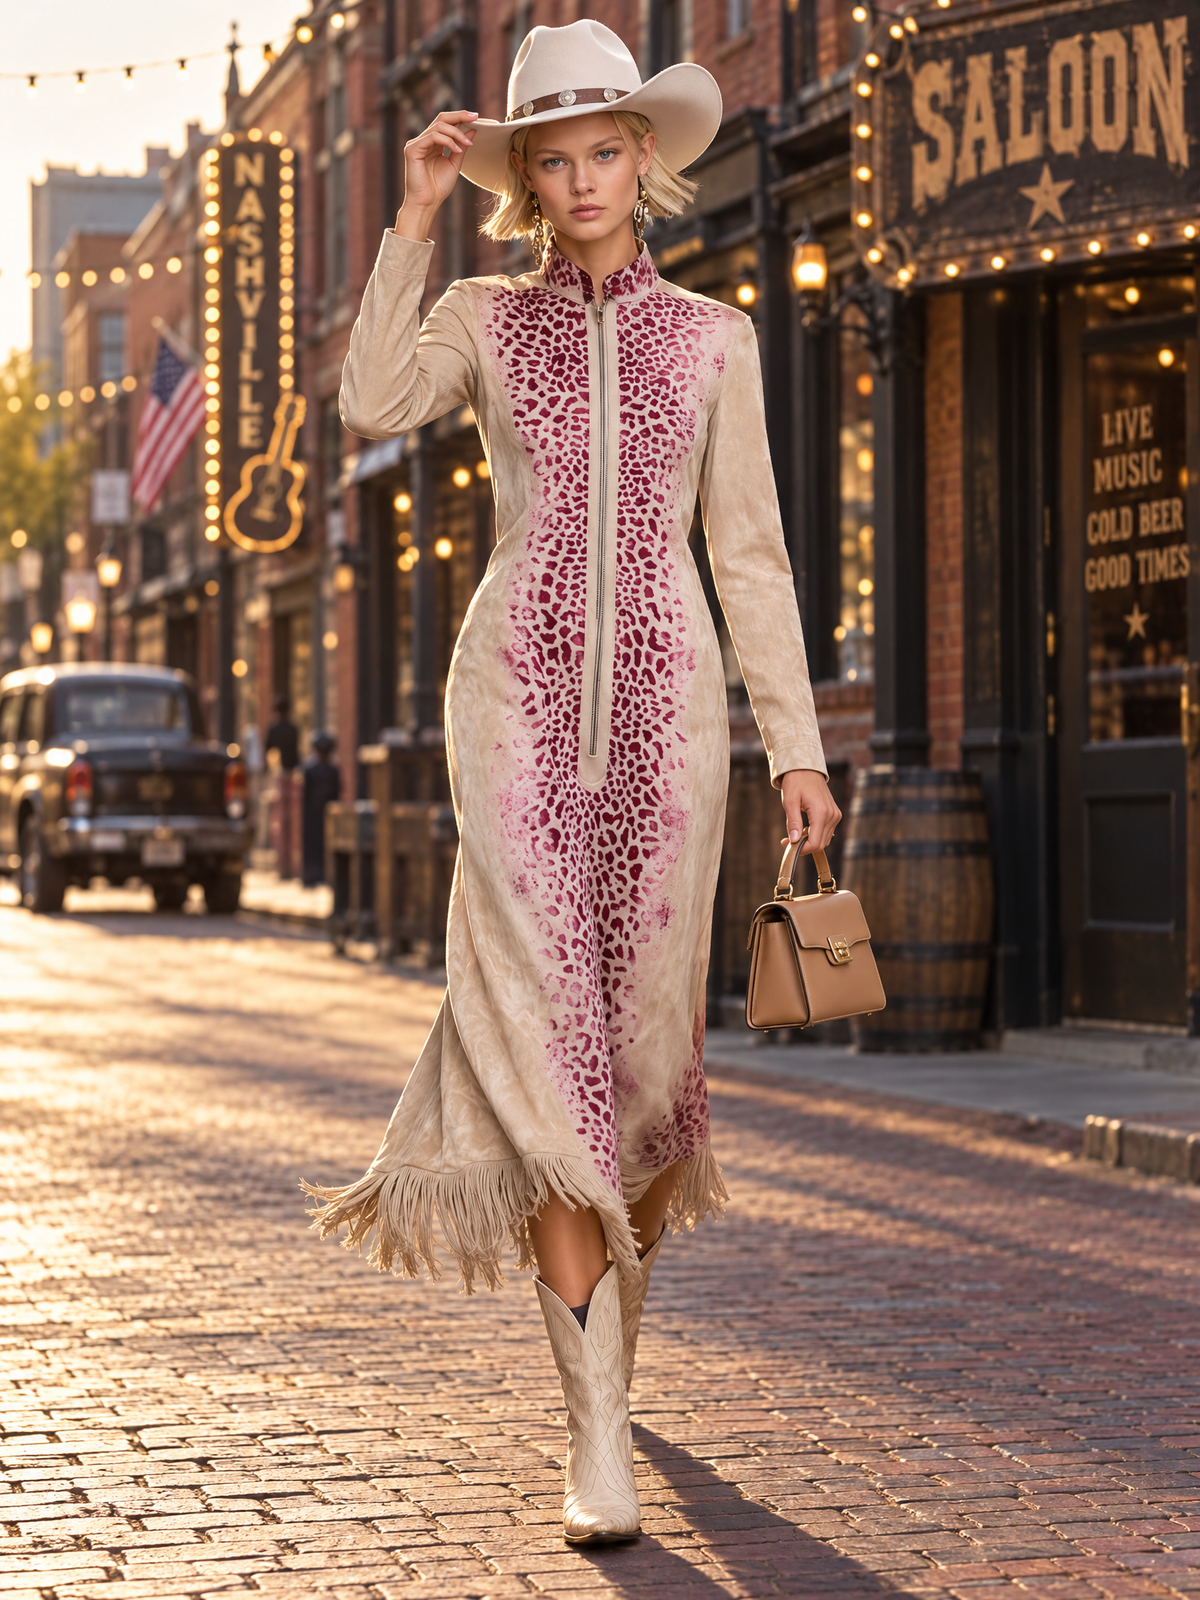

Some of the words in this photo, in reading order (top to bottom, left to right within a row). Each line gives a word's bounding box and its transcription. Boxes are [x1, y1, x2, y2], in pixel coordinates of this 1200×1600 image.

[912, 16, 1190, 211] SALOON
[233, 153, 266, 447] NASHVILLE
[1102, 405, 1153, 447] LIVE
[1093, 449, 1163, 494] MUSIC
[1087, 506, 1133, 546] COLD
[1138, 498, 1184, 537] BEER
[1085, 554, 1132, 593] GOOD
[1136, 544, 1190, 585] TIMES
